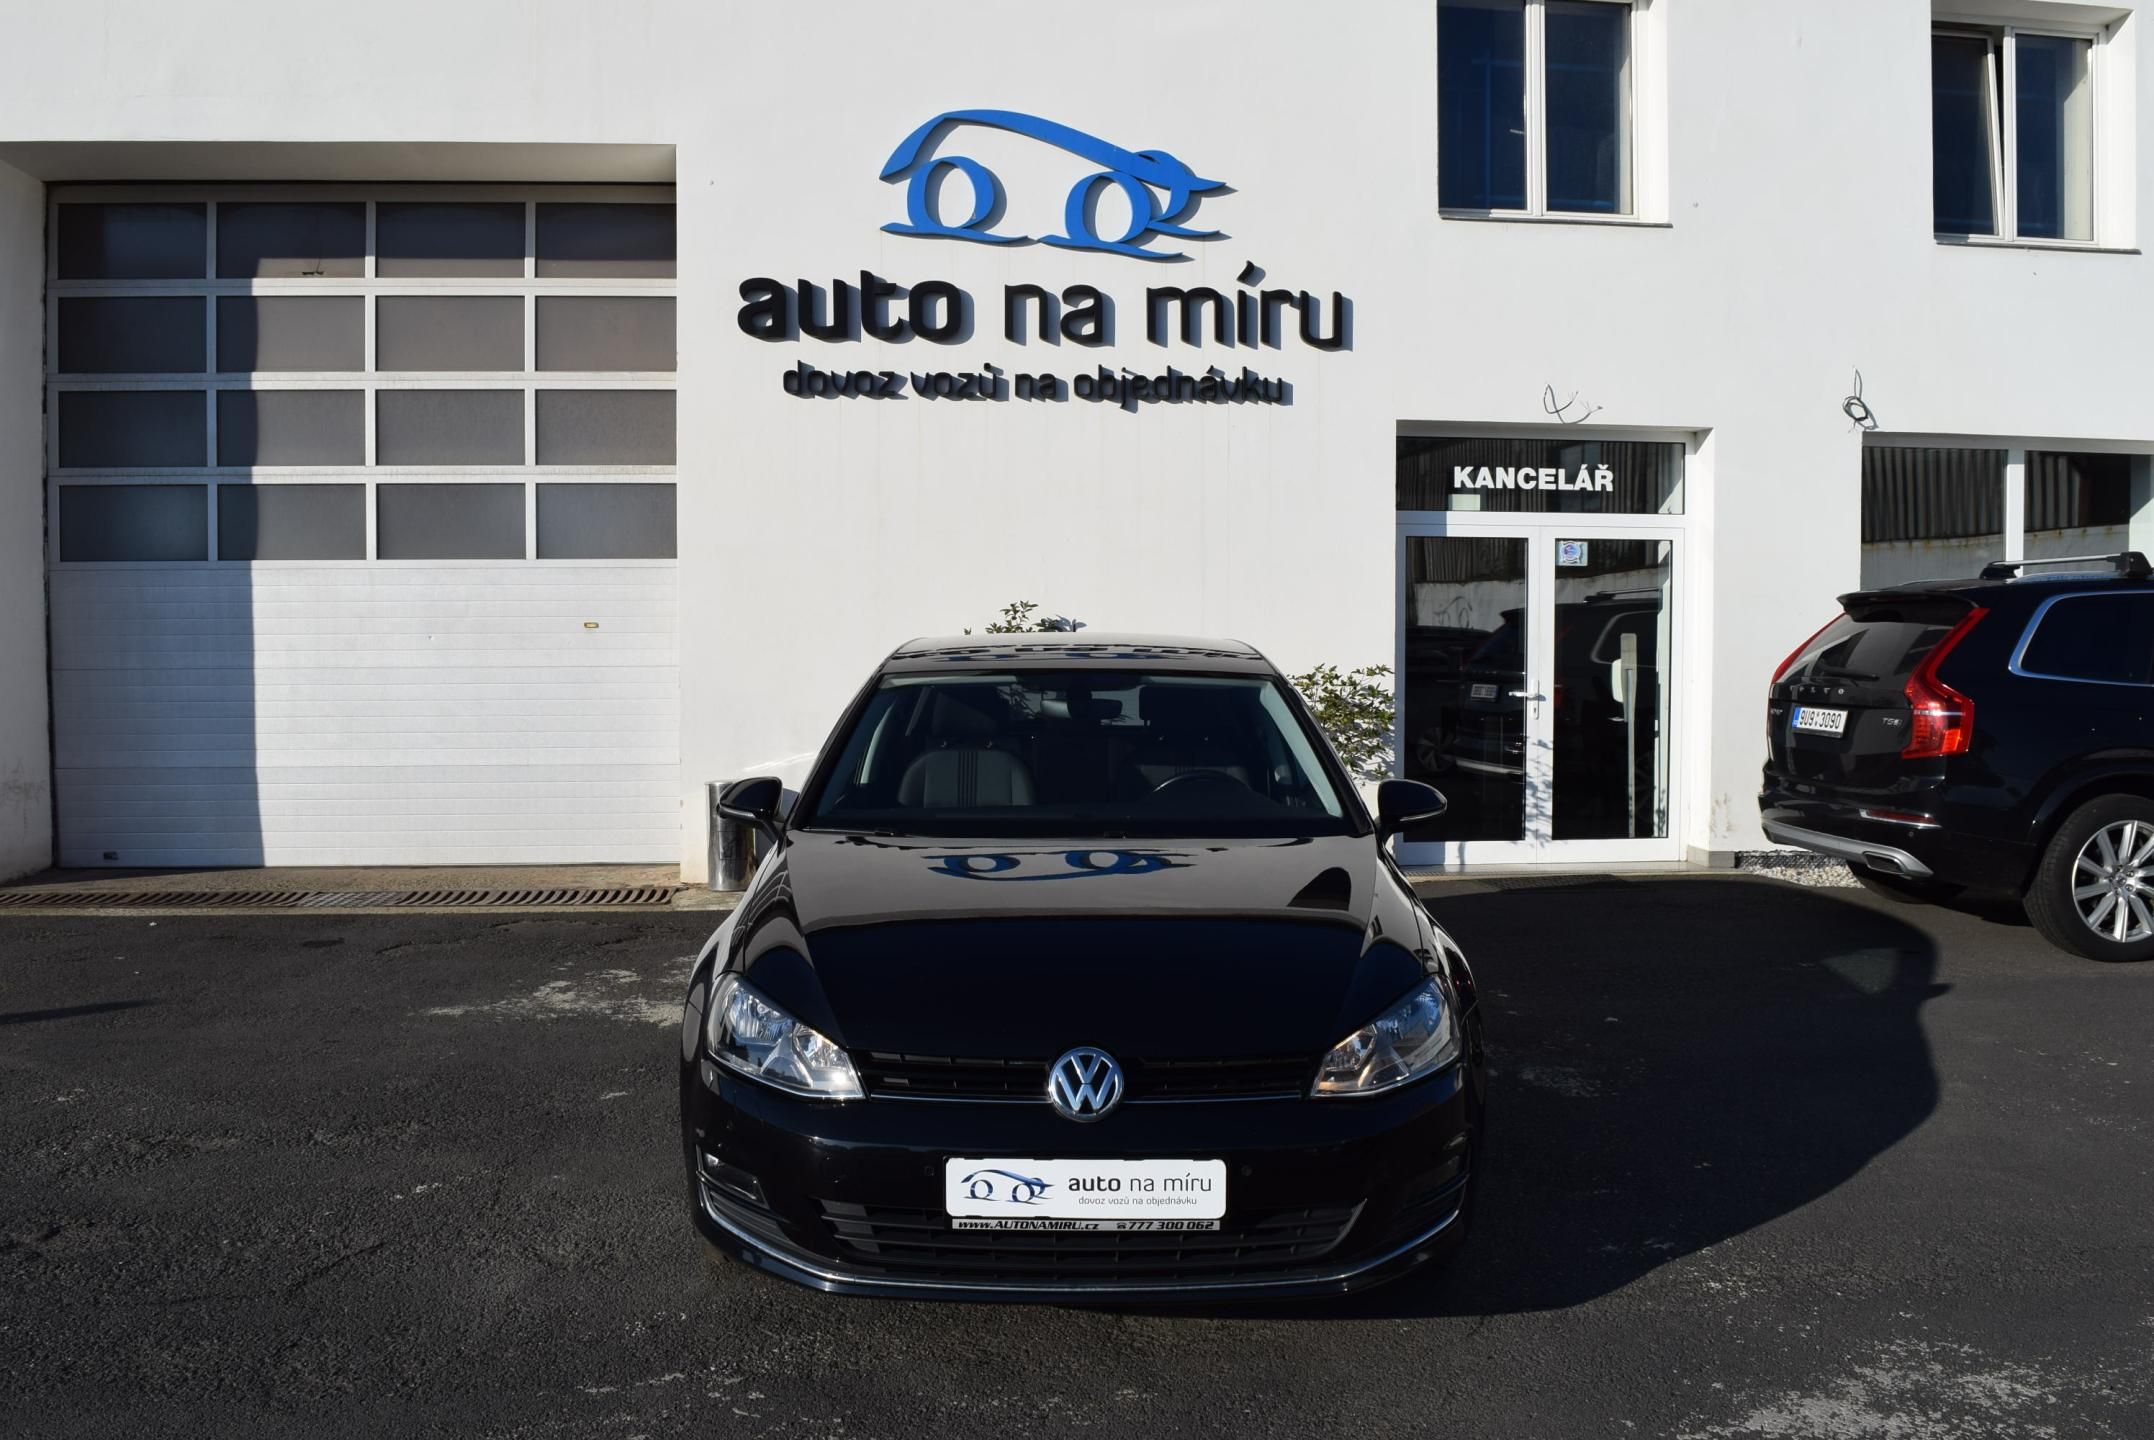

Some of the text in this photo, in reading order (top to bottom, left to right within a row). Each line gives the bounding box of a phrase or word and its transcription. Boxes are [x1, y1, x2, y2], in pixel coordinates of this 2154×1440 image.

[737, 260, 1345, 350] auto na míru
[783, 360, 1284, 410] dovoz vozů na objednávku
[1454, 464, 1614, 492] KANCELÁŘ
[1068, 1172, 1212, 1192] auto na míru
[1078, 1196, 1105, 1205] dovoz
[1132, 1197, 1144, 1205] na
[1146, 1196, 1197, 1207] objednávku
[958, 1220, 1214, 1230] www.AUTONAMIRU.cz 777 300 062
